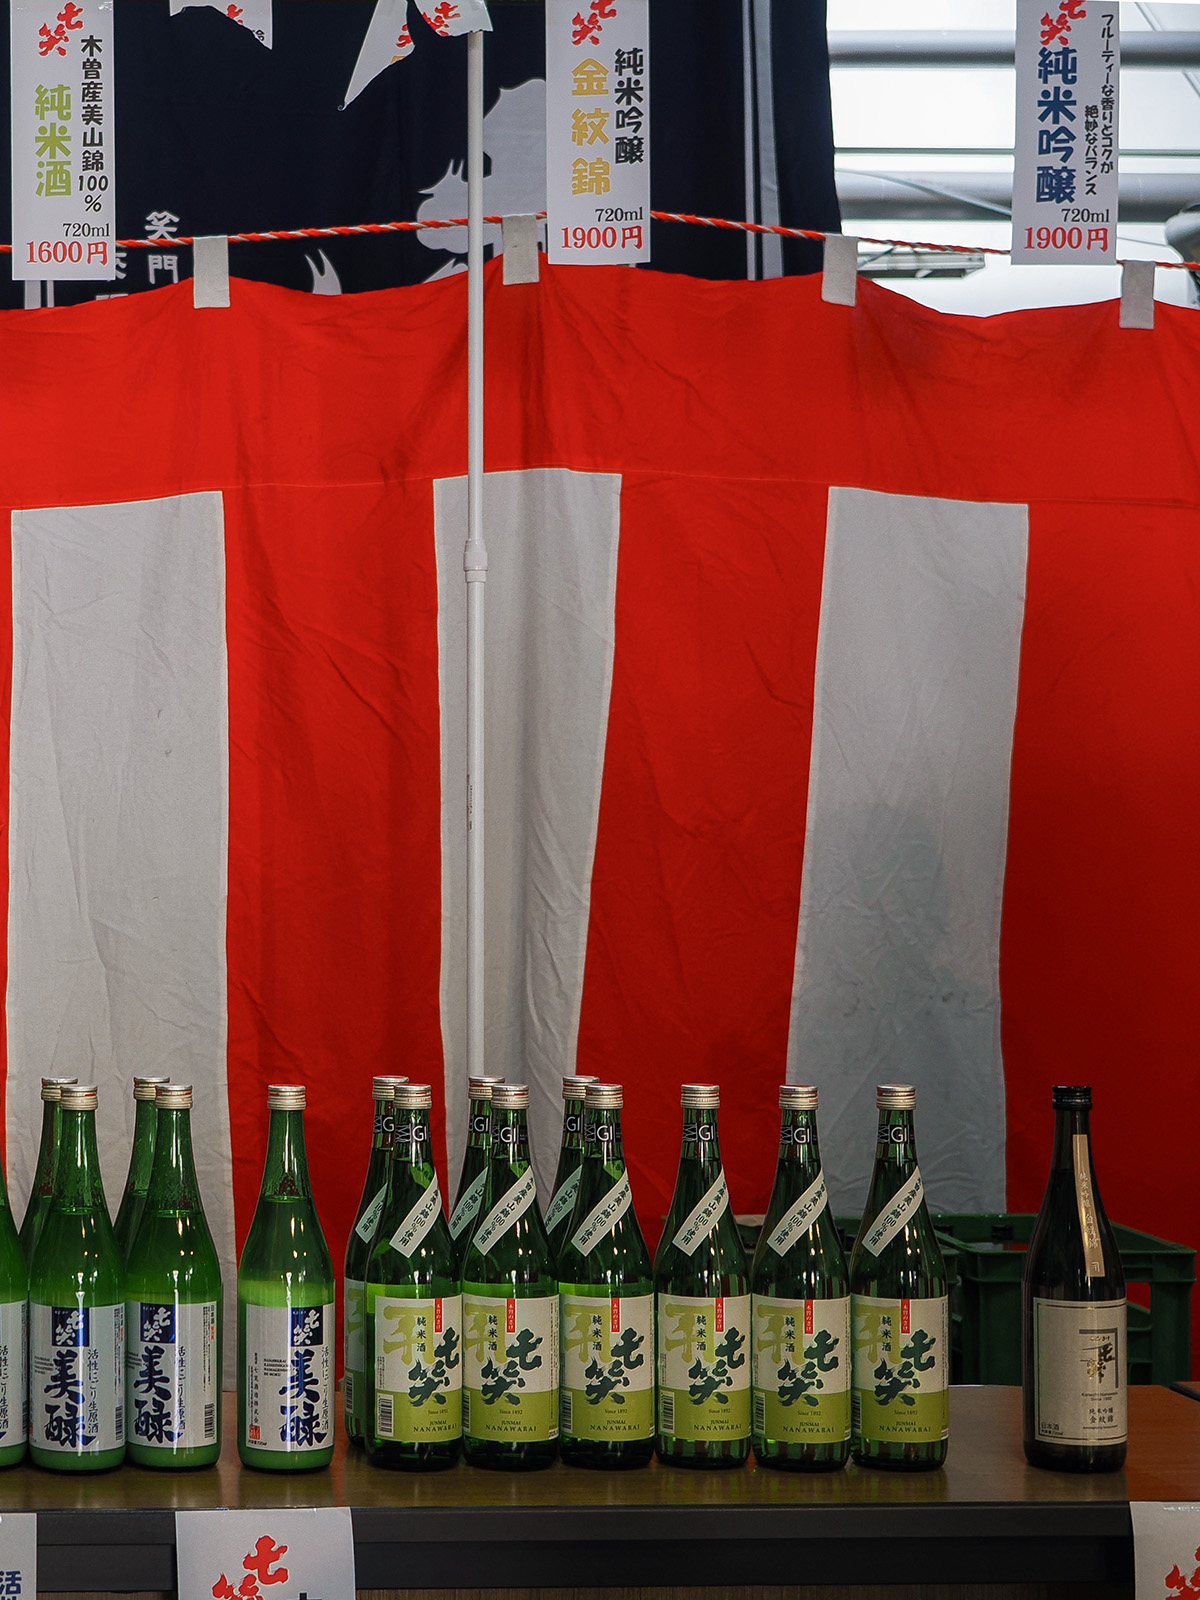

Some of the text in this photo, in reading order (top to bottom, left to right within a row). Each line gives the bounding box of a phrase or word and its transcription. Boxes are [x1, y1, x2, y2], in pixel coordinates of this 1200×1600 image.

[38, 1, 84, 57] 七笑
[614, 47, 645, 165] 純米吟醸
[1100, 14, 1116, 174] フルーティーな香りとコクが
[34, 83, 73, 198] 純米酒
[571, 57, 611, 196] 金紋錦
[1036, 46, 1078, 205] 純米吟醸
[1083, 104, 1100, 196] 絶妙なバランス
[62, 223, 110, 238] 720ml
[594, 206, 644, 222] 720ml
[1061, 207, 1110, 223] 720ml
[26, 240, 109, 266] 1600円
[144, 210, 181, 285] 笑門
[560, 225, 643, 250] 1900円
[1023, 227, 1109, 252] 1900円
[412, 1125, 428, 1142] GI
[500, 1127, 517, 1143] GI
[596, 1125, 613, 1141] GI
[698, 1125, 714, 1141] GI
[793, 1127, 810, 1144] GI
[891, 1127, 908, 1143] GI
[416, 1316, 427, 1352] 純米酒
[487, 1314, 499, 1351] 純米酒
[592, 1315, 603, 1351] 純米酒
[696, 1315, 707, 1351] 純米酒
[784, 1316, 796, 1352] 純米酒
[881, 1316, 892, 1352] 純米酒
[408, 1326, 460, 1407] 七笑
[481, 1328, 544, 1406] 七笑
[585, 1327, 645, 1405] 七笑
[688, 1327, 746, 1405] 七笑
[777, 1329, 840, 1407] 七笑
[873, 1329, 937, 1406] 七笑
[413, 1423, 458, 1433] NANAWARAI
[485, 1424, 537, 1432] NANAWARAI
[782, 1425, 835, 1433] NANAWARAI
[879, 1425, 932, 1433] NANAWARAI
